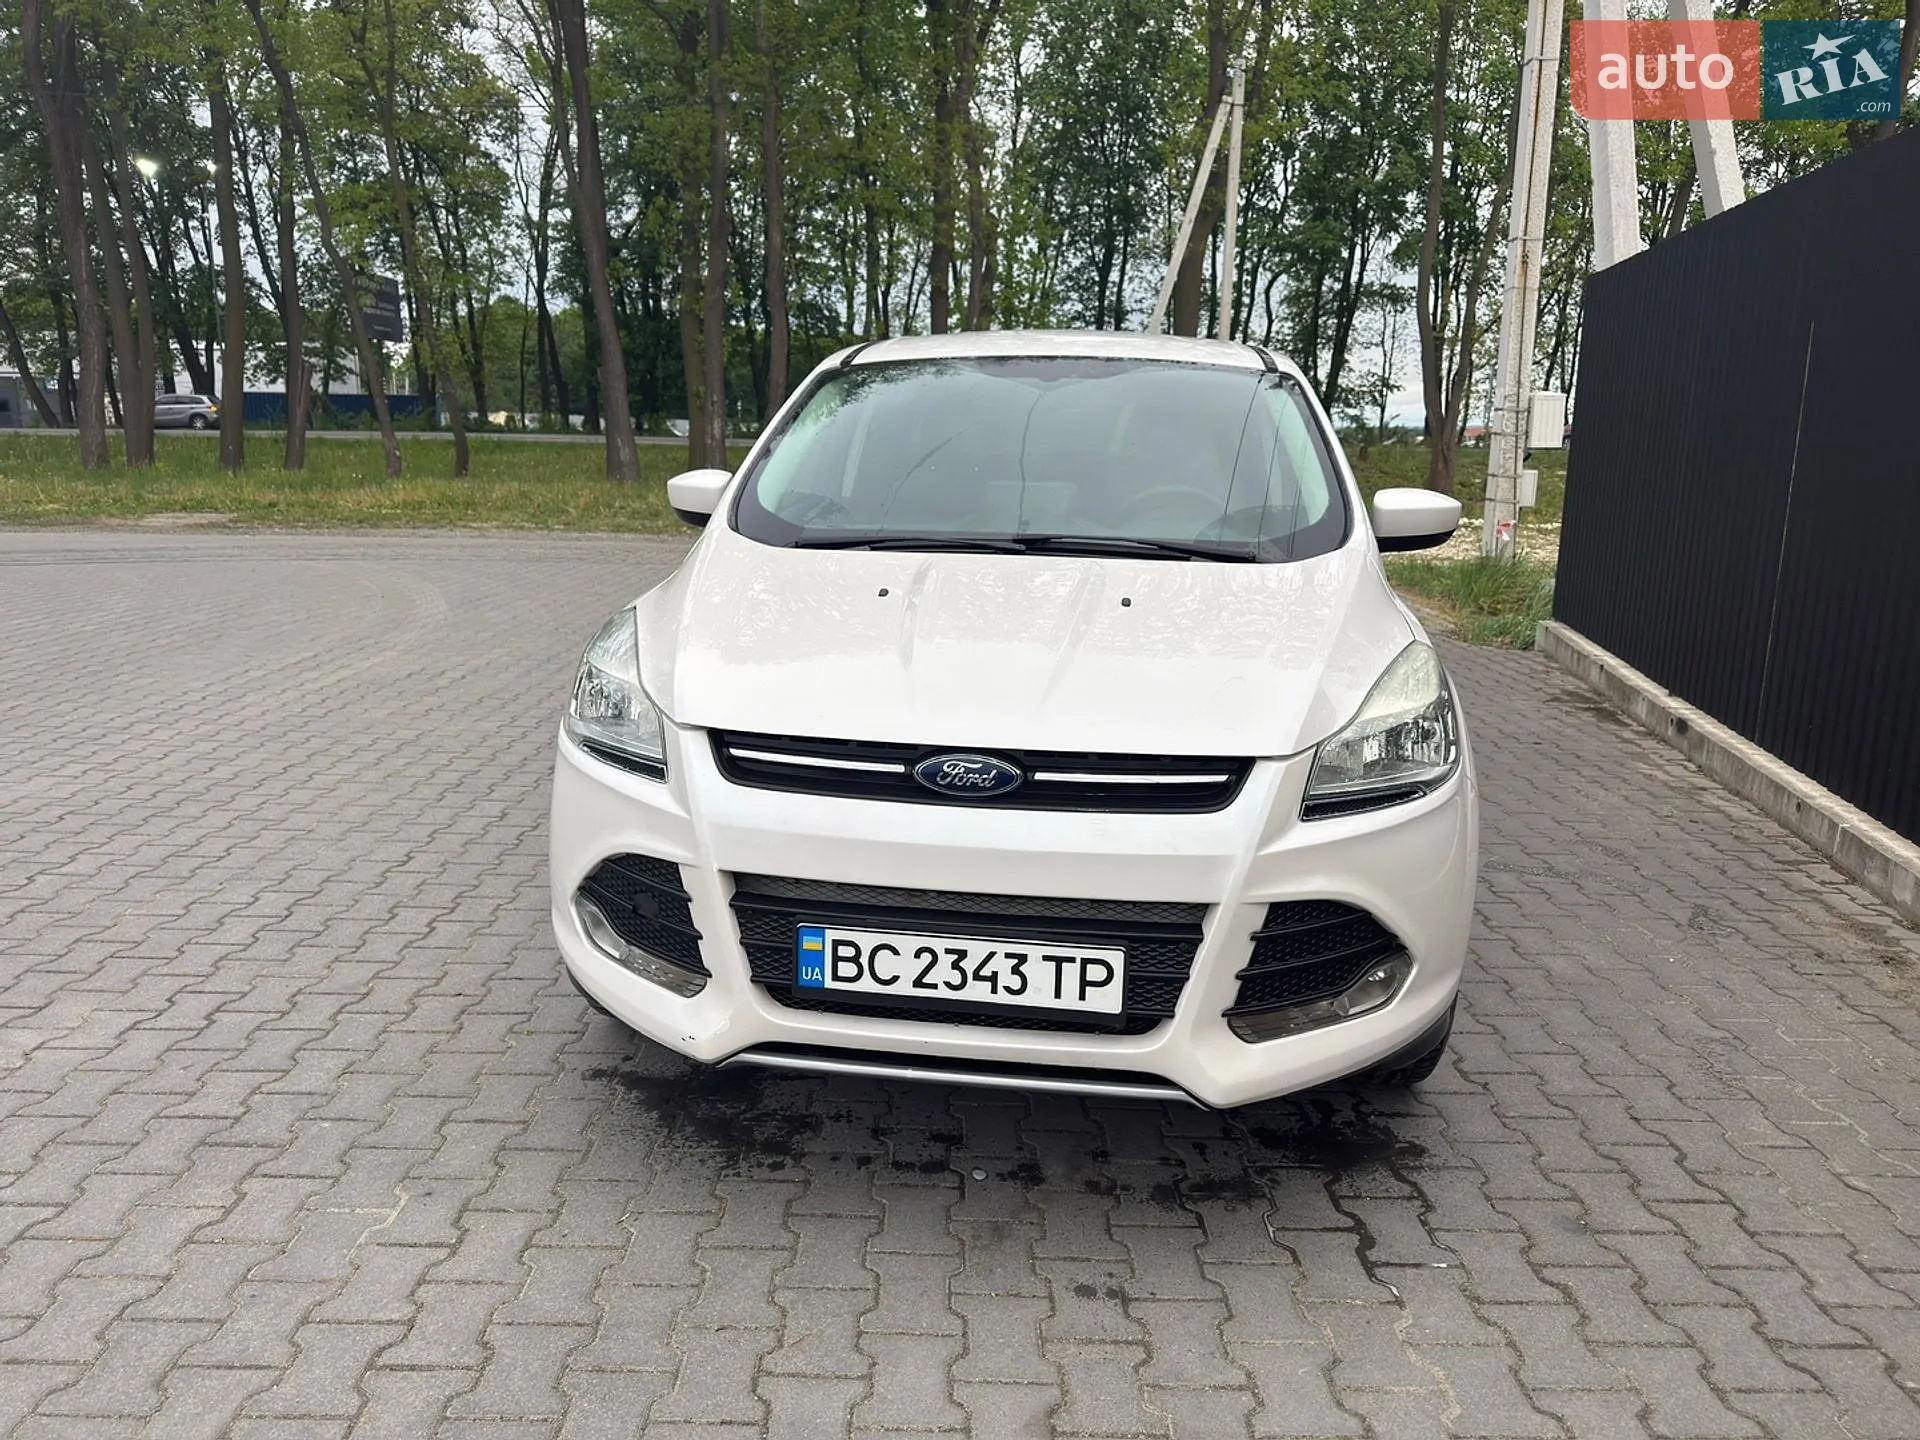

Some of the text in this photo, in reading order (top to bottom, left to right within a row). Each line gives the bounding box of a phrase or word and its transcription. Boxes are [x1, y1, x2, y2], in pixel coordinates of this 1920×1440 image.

[936, 761, 998, 788] Ford
[802, 965, 823, 982] UA
[831, 938, 1115, 1002] BC 2343 TP
